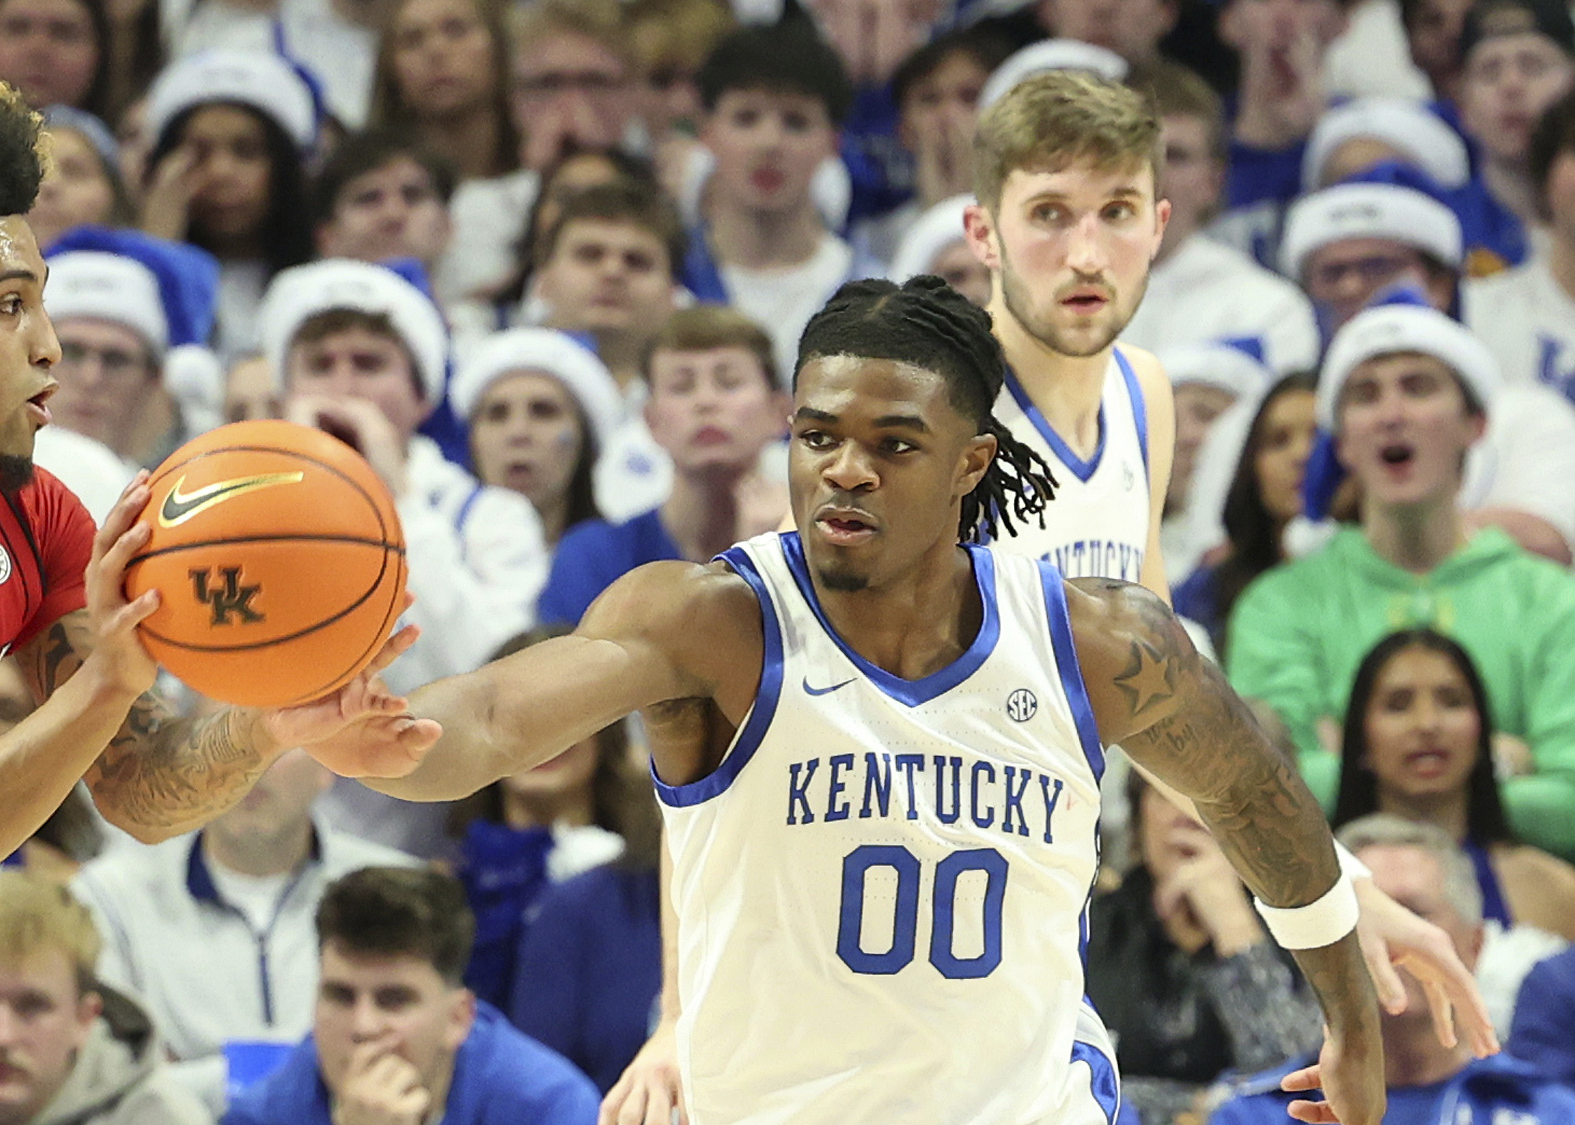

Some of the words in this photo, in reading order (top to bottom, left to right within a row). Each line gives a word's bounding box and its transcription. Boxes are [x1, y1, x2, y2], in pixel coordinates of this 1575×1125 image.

[188, 565, 266, 627] UK
[1007, 689, 1037, 722] SEC
[786, 752, 1064, 844] KENTUCKY
[836, 845, 1009, 979] 00
